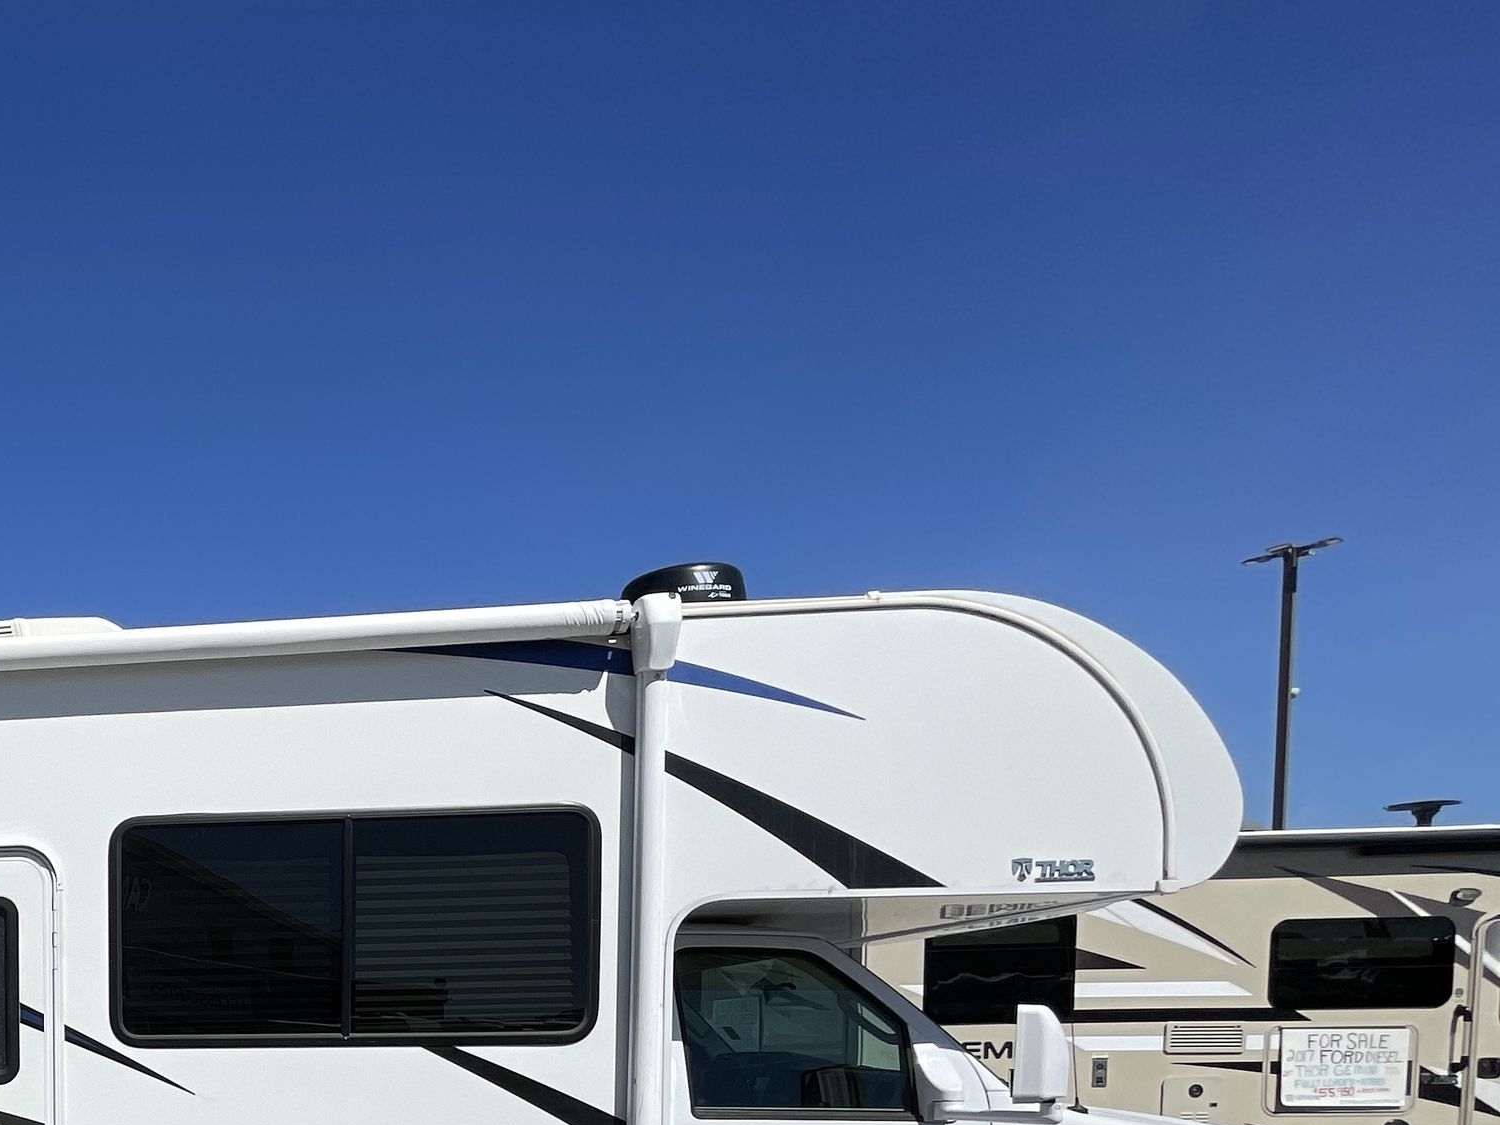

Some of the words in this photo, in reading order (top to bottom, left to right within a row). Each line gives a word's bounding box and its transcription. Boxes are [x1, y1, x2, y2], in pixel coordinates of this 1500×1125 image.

[677, 584, 732, 592] WINEGARD
[1035, 859, 1095, 878] THOR
[961, 1041, 1013, 1059] EM
[1308, 1033, 1342, 1049] FOR
[1346, 1032, 1391, 1050] SALE
[1319, 1049, 1365, 1065] FORD
